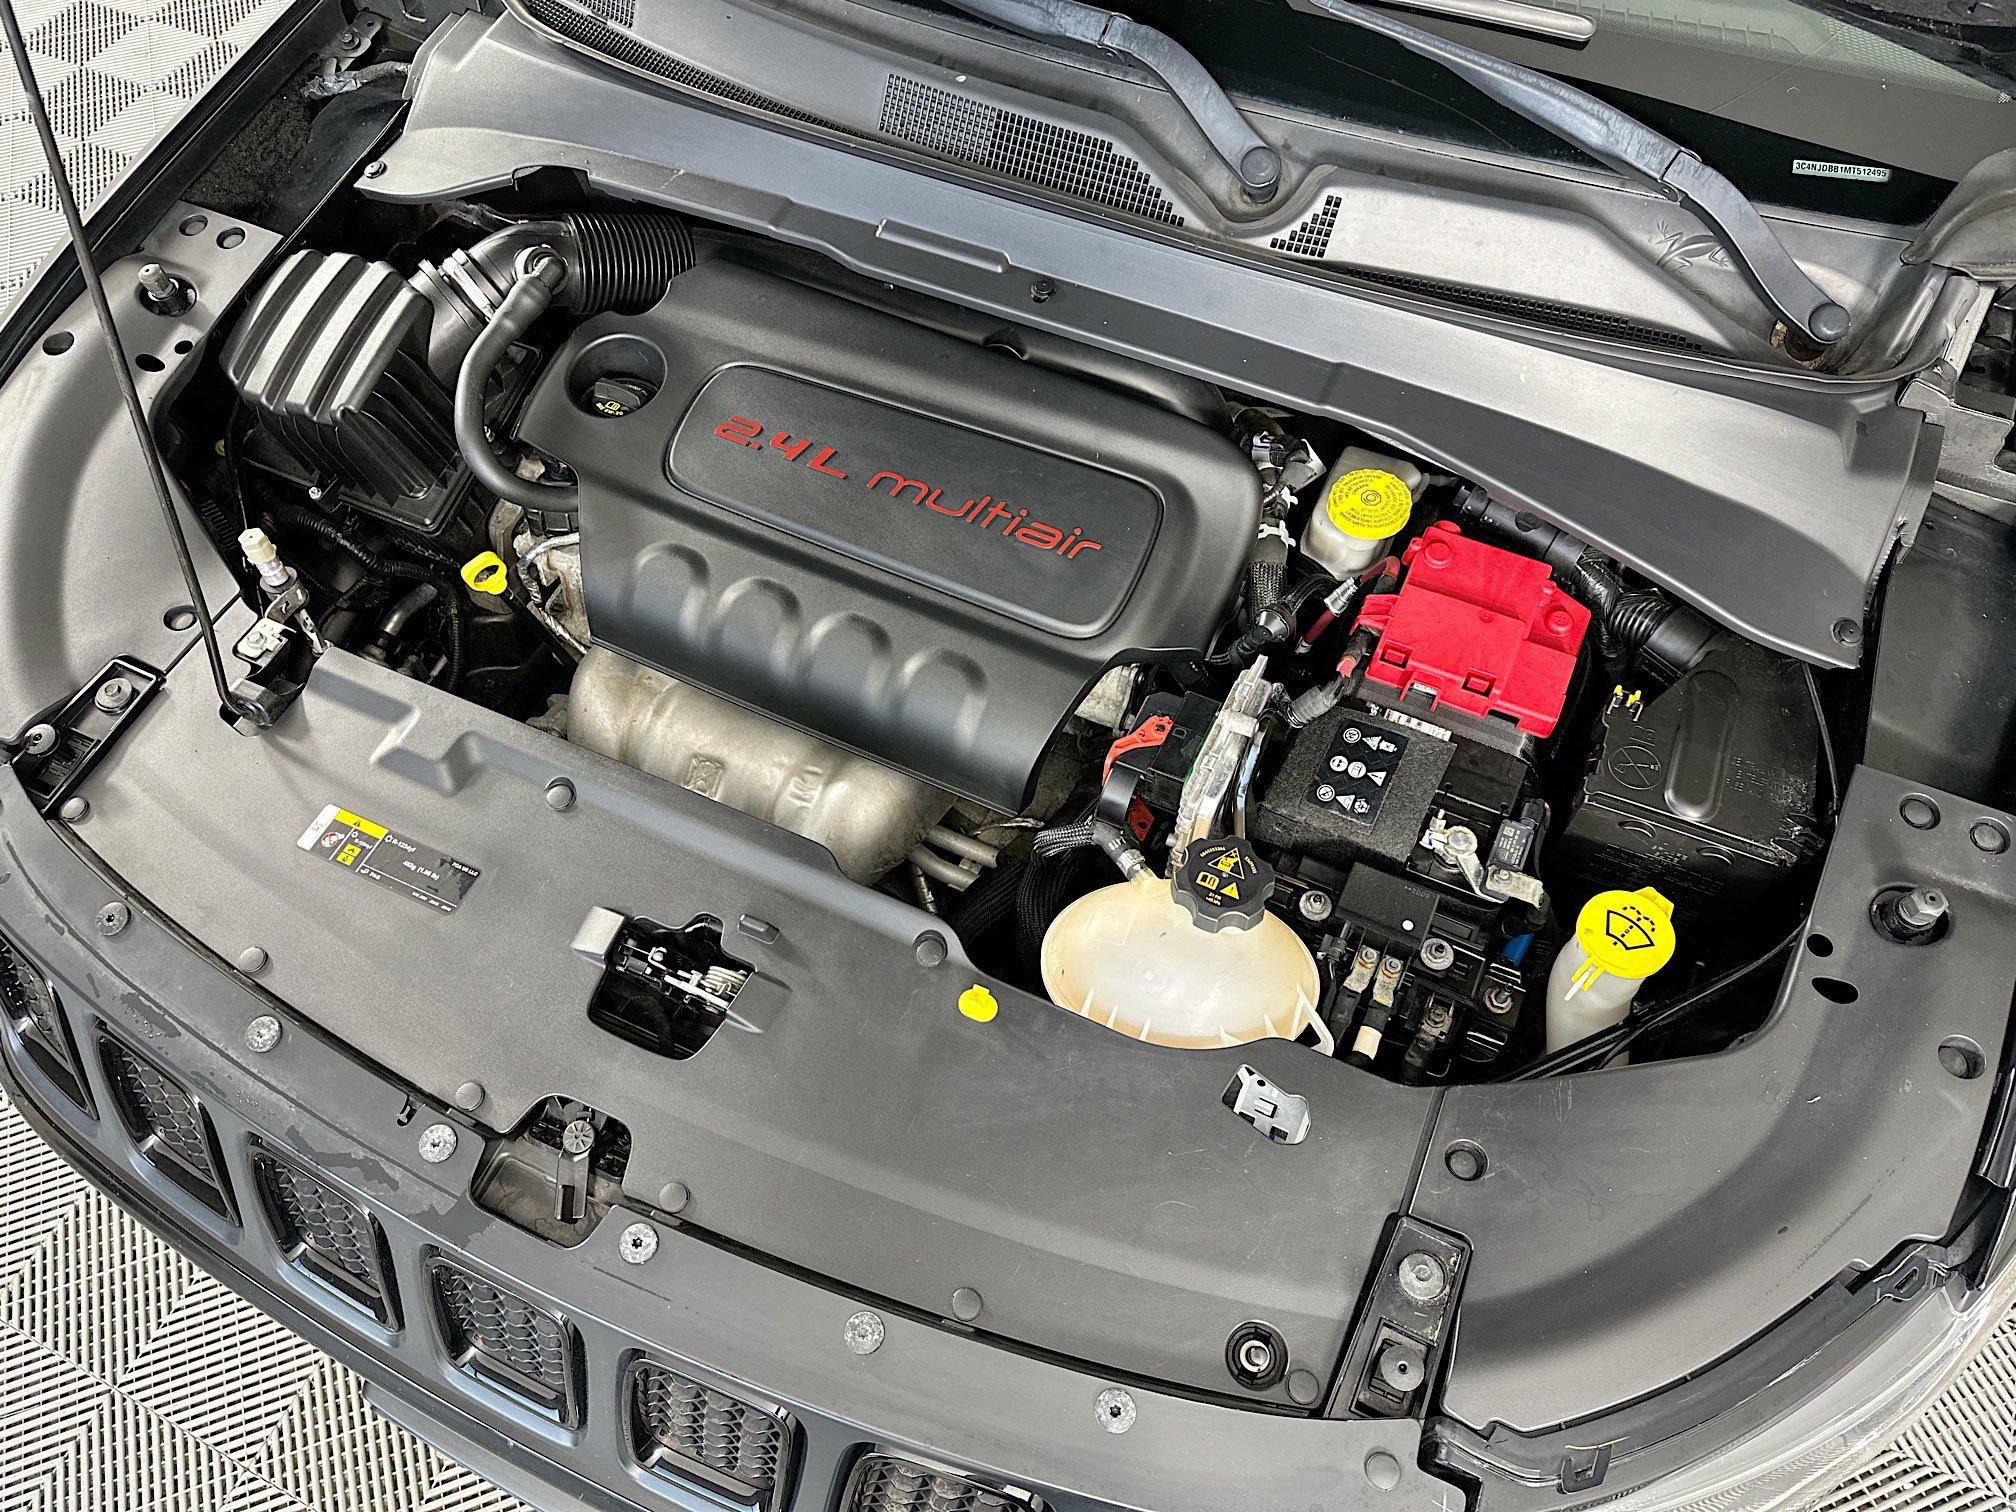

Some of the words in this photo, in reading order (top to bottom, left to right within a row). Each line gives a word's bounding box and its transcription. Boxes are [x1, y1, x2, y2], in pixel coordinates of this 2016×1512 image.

[1795, 162, 1887, 177] 3C4NJDBB1MT512495
[714, 415, 848, 480] 2.4L
[866, 470, 1101, 559] multiair
